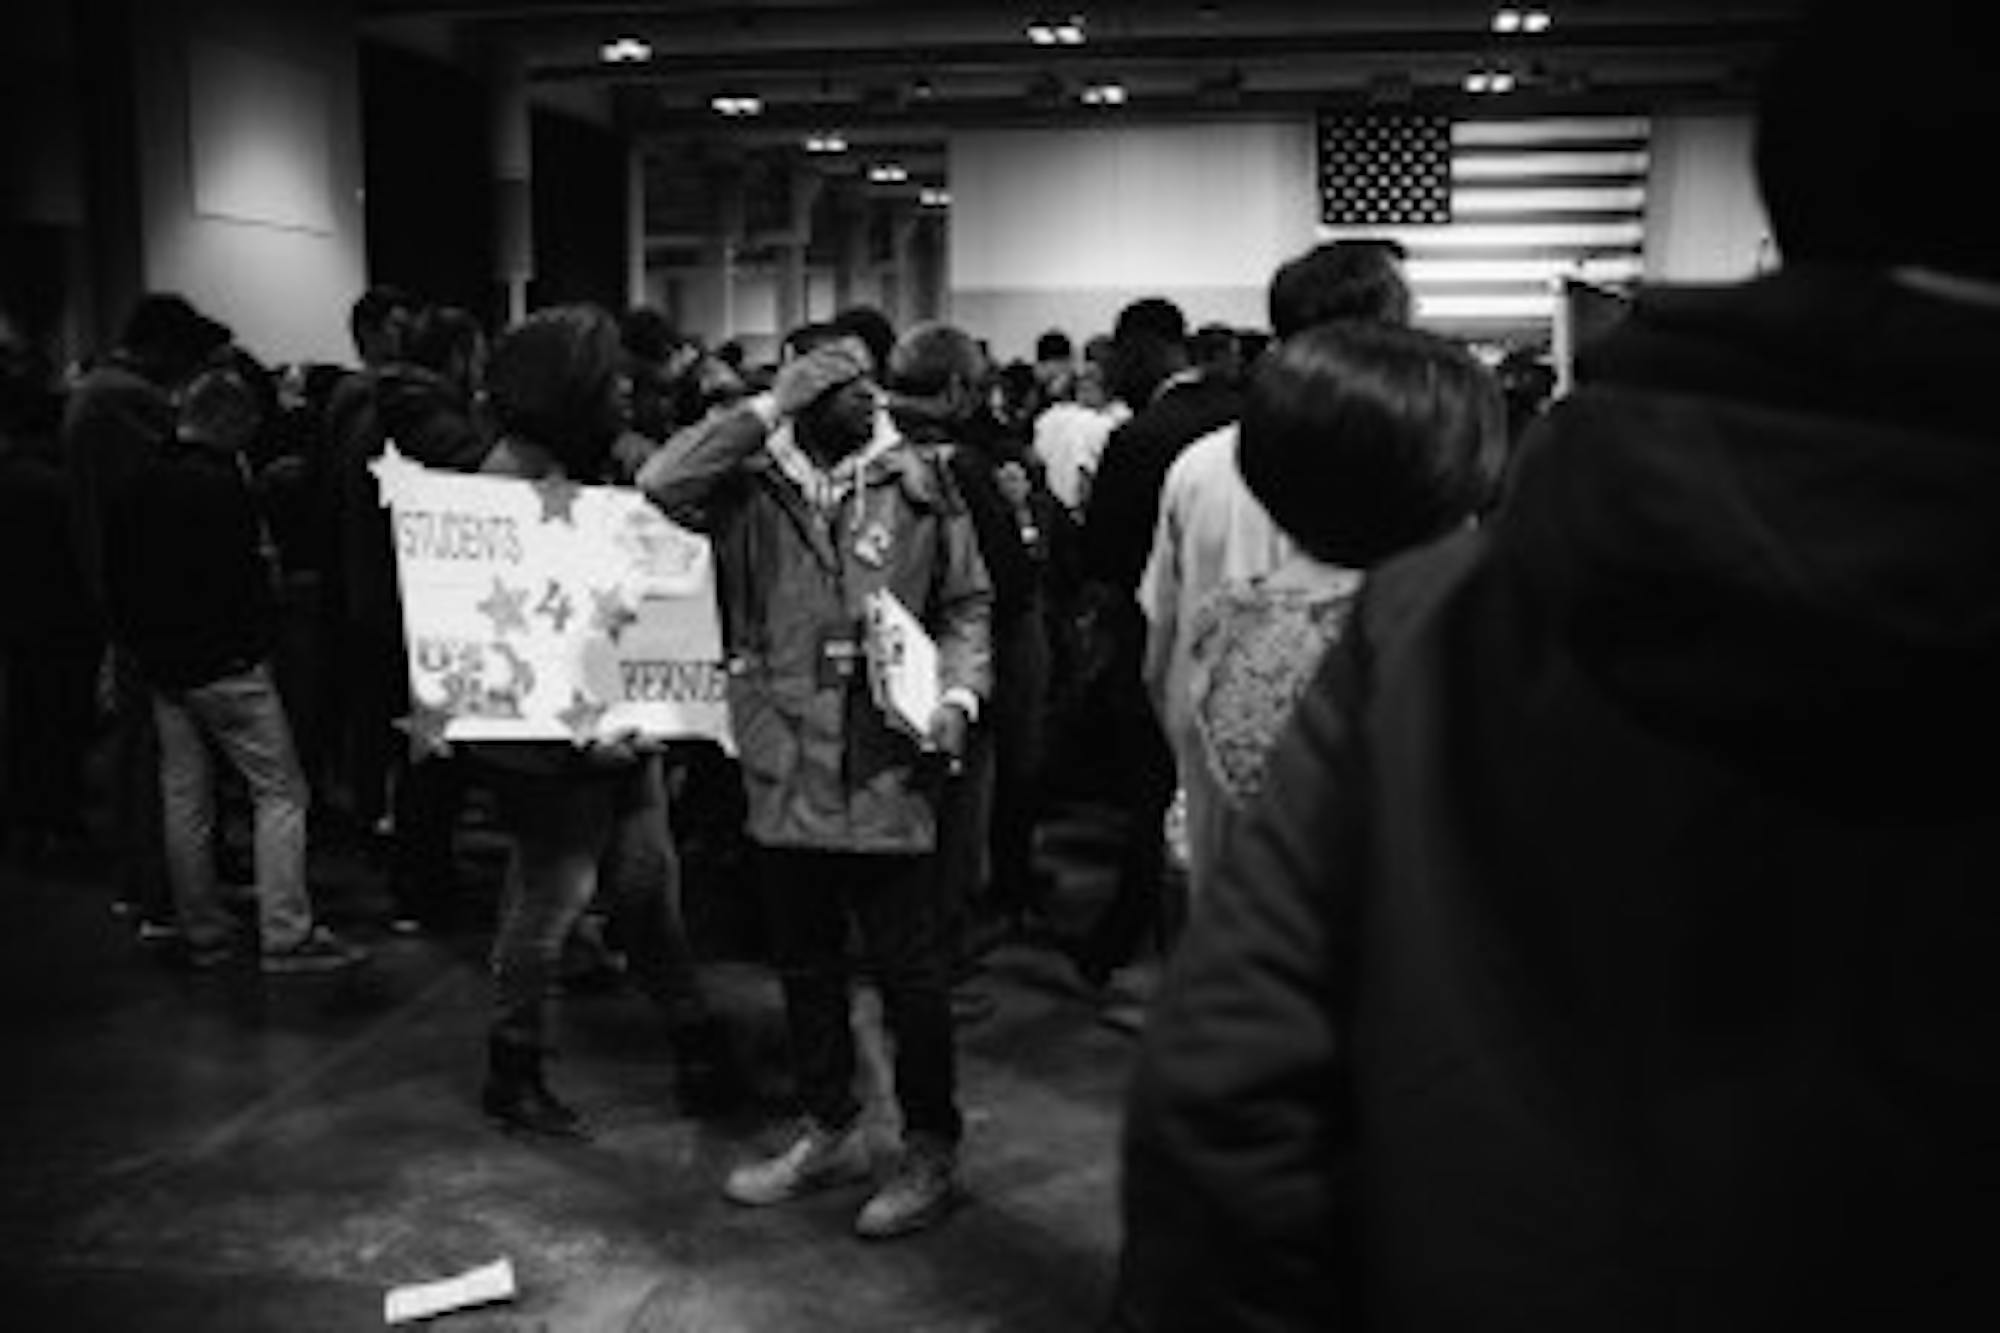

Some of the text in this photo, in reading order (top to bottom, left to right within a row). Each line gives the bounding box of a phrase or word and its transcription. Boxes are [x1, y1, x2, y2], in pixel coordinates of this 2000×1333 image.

[400, 510, 523, 565] STUDENTS
[534, 579, 573, 633] 4
[619, 658, 726, 703] BERNIE
